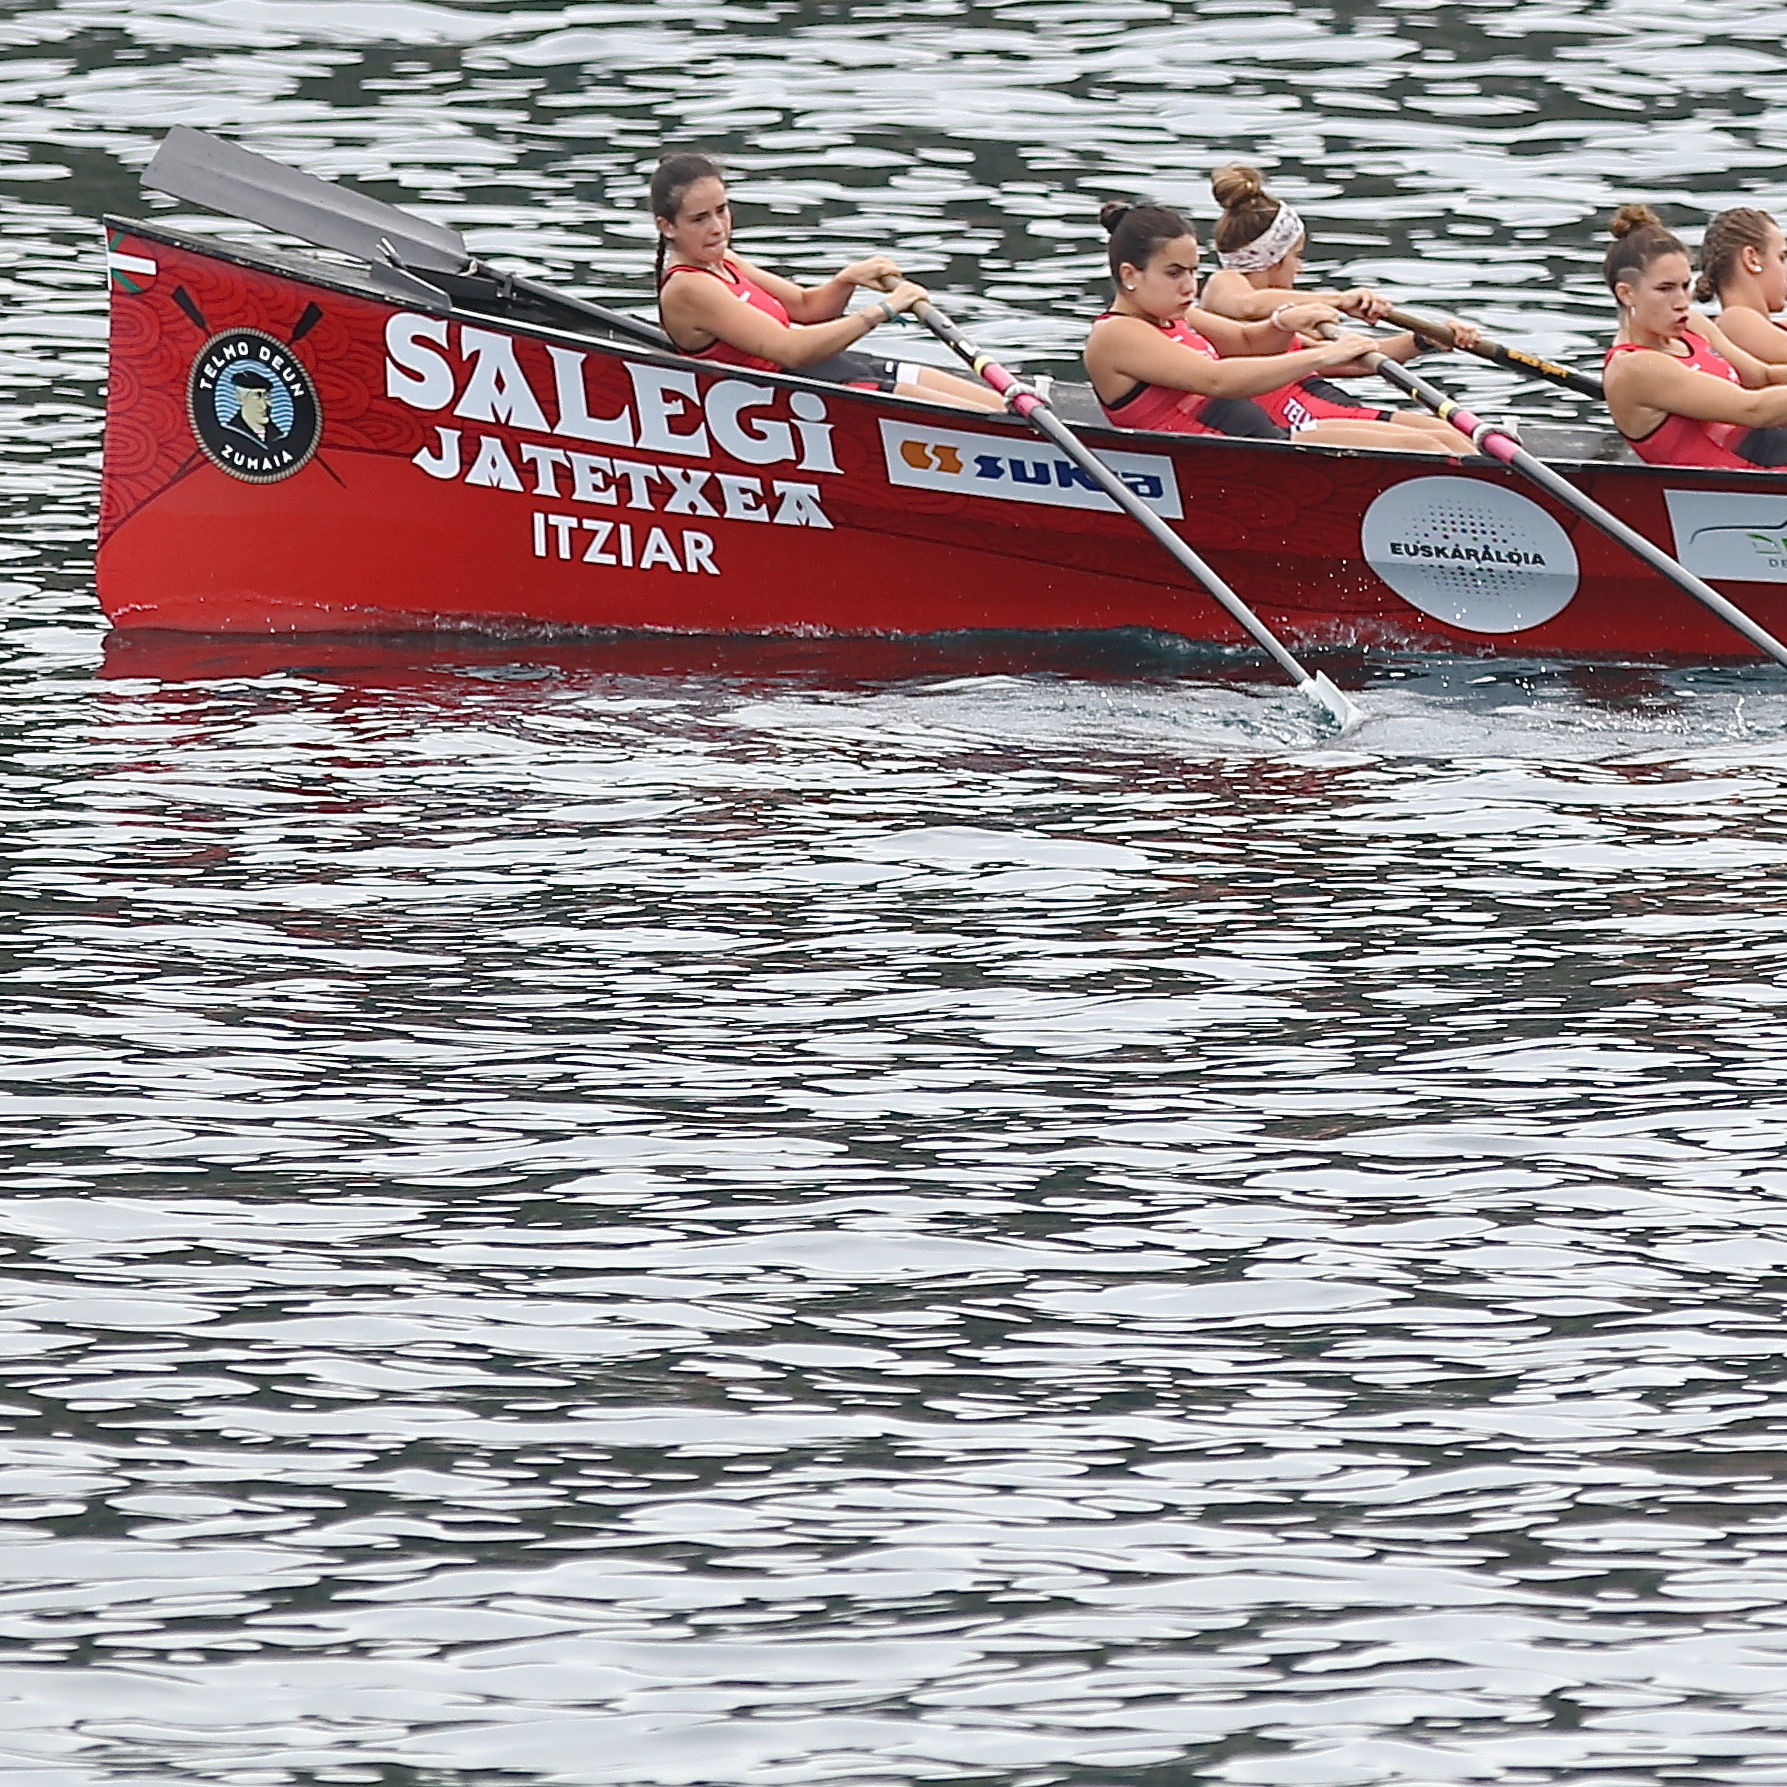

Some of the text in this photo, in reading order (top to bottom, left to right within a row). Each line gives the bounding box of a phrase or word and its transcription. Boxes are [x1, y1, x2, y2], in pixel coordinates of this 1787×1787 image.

[199, 341, 304, 397] TELMO DEUN
[220, 444, 294, 471] ZUMAIA
[412, 425, 835, 530] JATETXEA
[533, 512, 722, 576] ITZIAR
